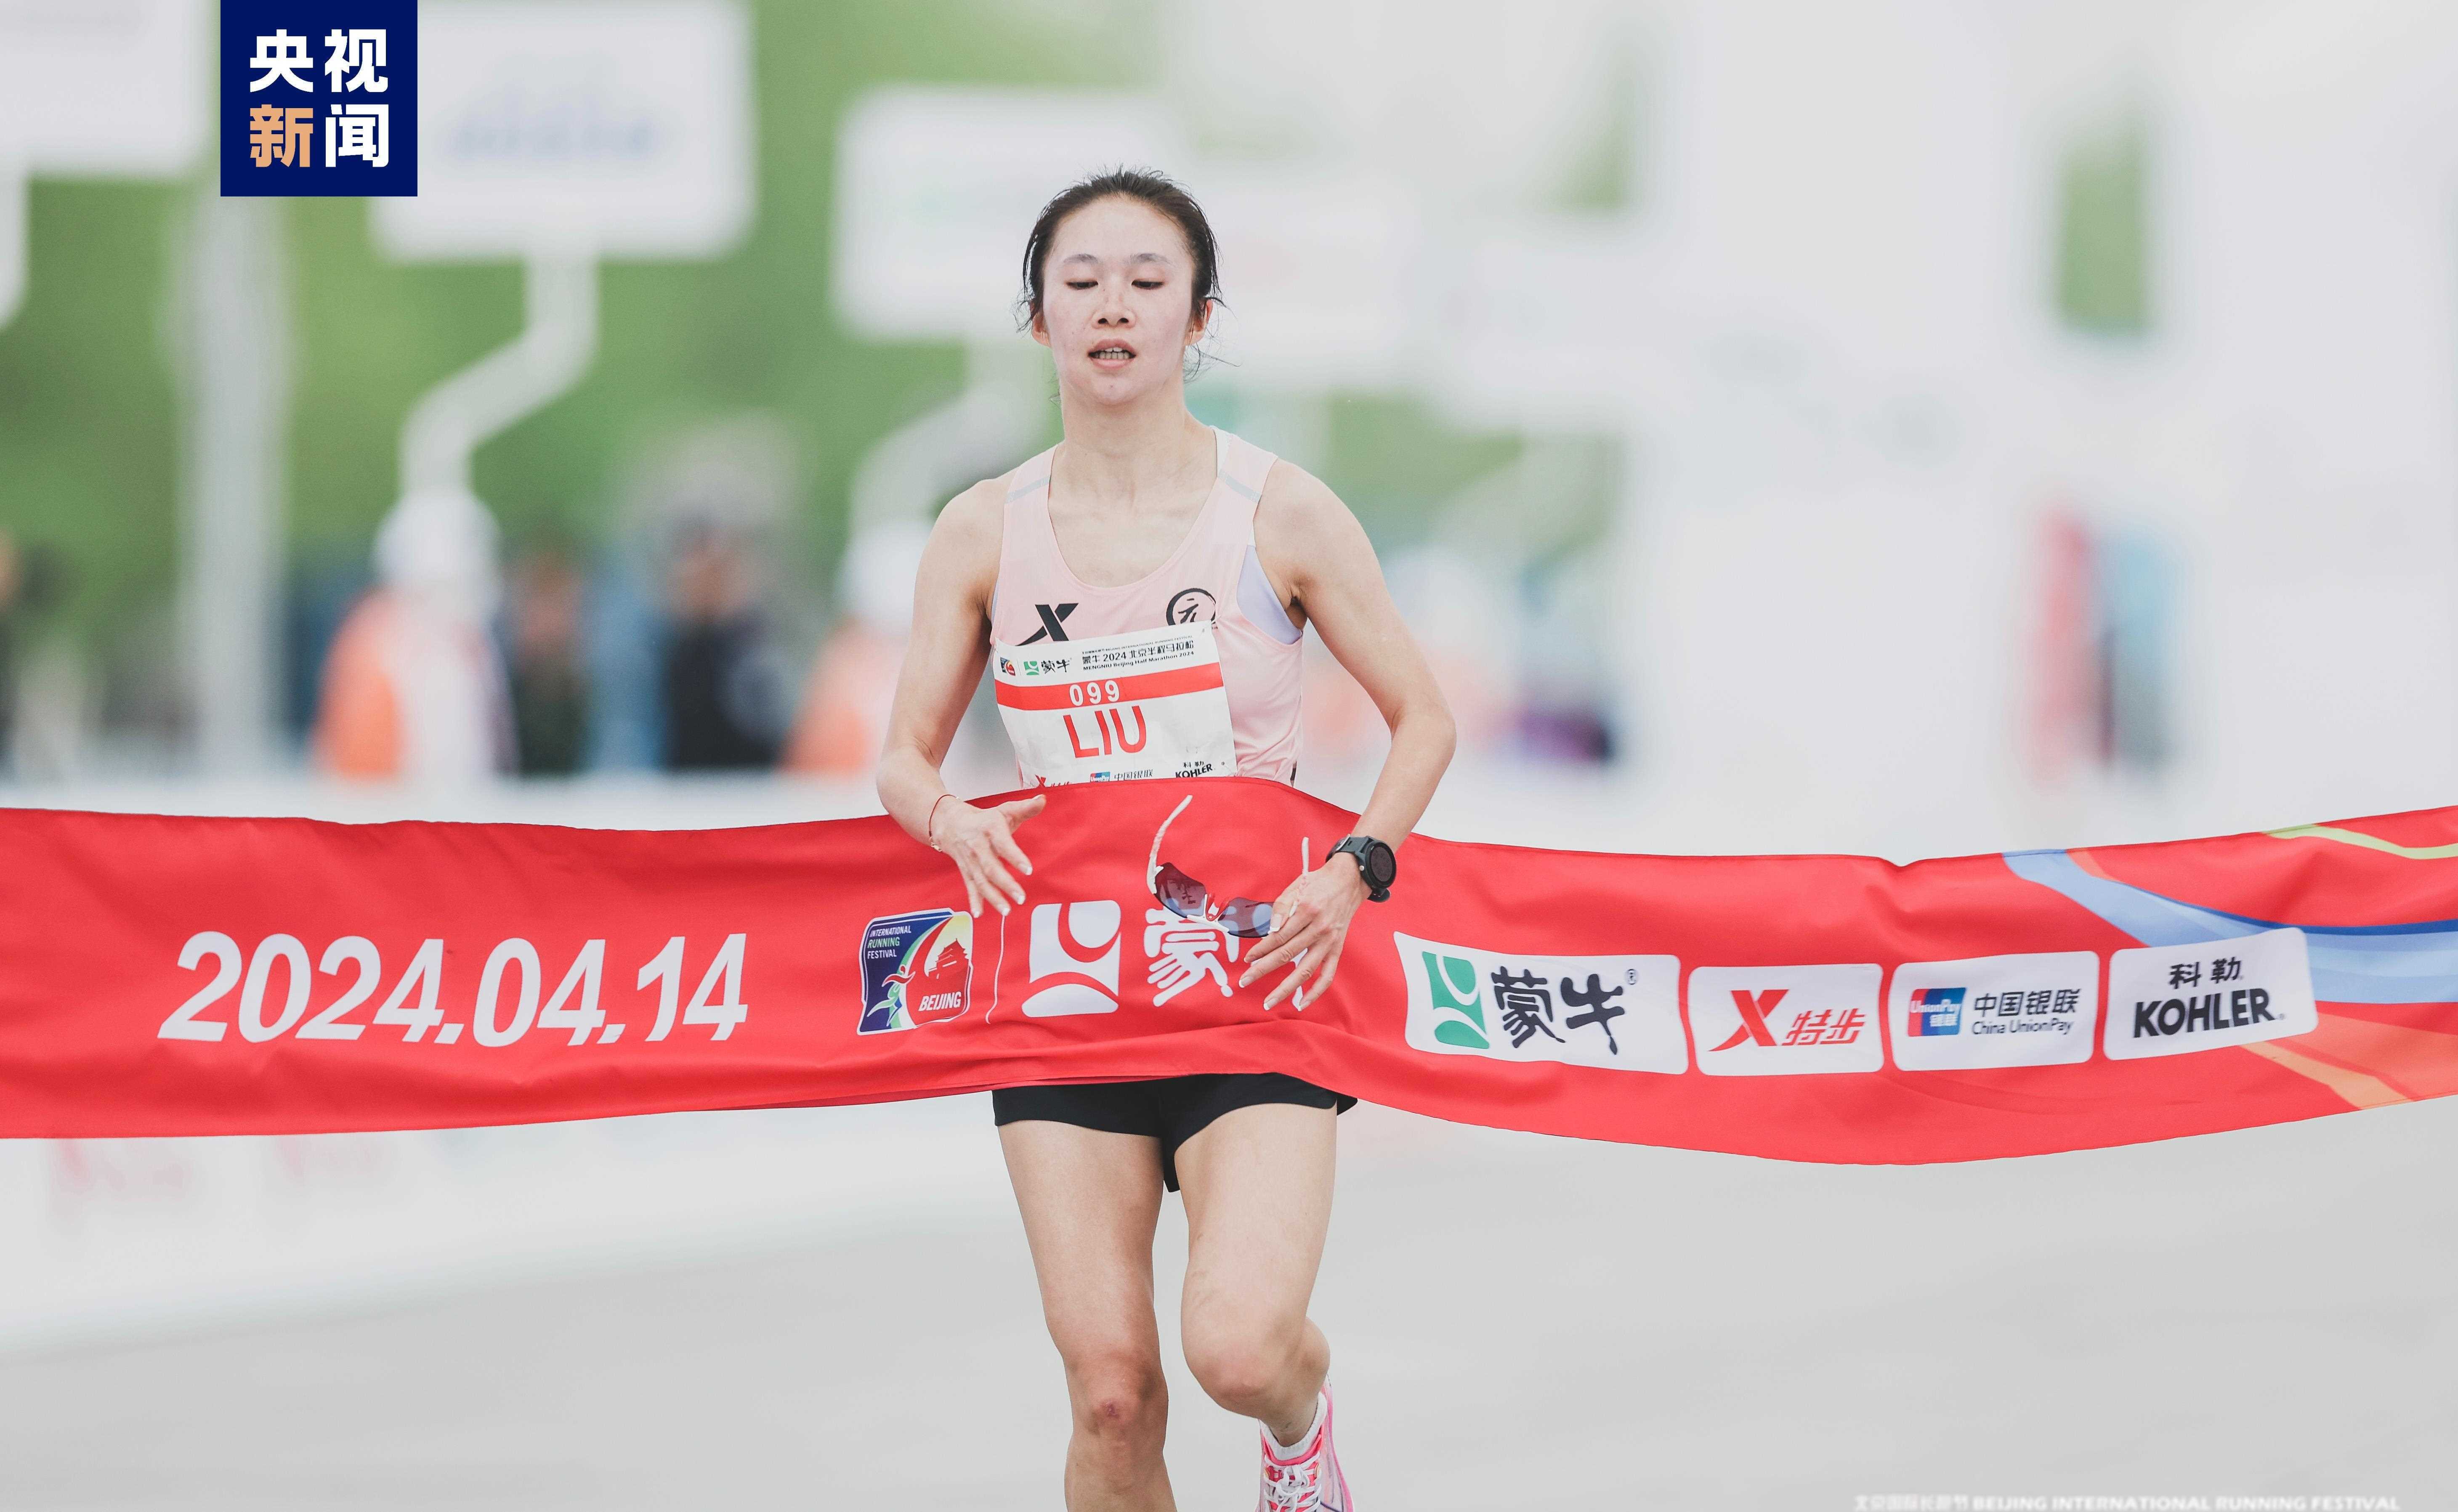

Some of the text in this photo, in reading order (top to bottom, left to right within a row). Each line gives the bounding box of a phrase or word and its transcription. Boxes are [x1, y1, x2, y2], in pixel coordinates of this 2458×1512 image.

[1103, 652, 1127, 662] 2024
[1129, 640, 1194, 658] 北京半程马拉松
[1041, 659, 1070, 674] 蒙牛
[1069, 679, 1120, 706] 099
[1063, 706, 1147, 759] LIU
[1175, 764, 1213, 778] KOHLER
[867, 936, 900, 948] RUNNING
[869, 925, 911, 938] INTERNATIONAL
[867, 949, 897, 959] FESTIVAL
[157, 931, 748, 1048] 2024.04.14
[918, 991, 962, 1011] BEIJING
[1491, 966, 1625, 1056] 蒙牛
[1974, 988, 2081, 1017] 中国银联
[2133, 988, 2276, 1038] KOHLER
[1782, 1008, 1866, 1046] 特步
[1972, 1019, 2006, 1035] China
